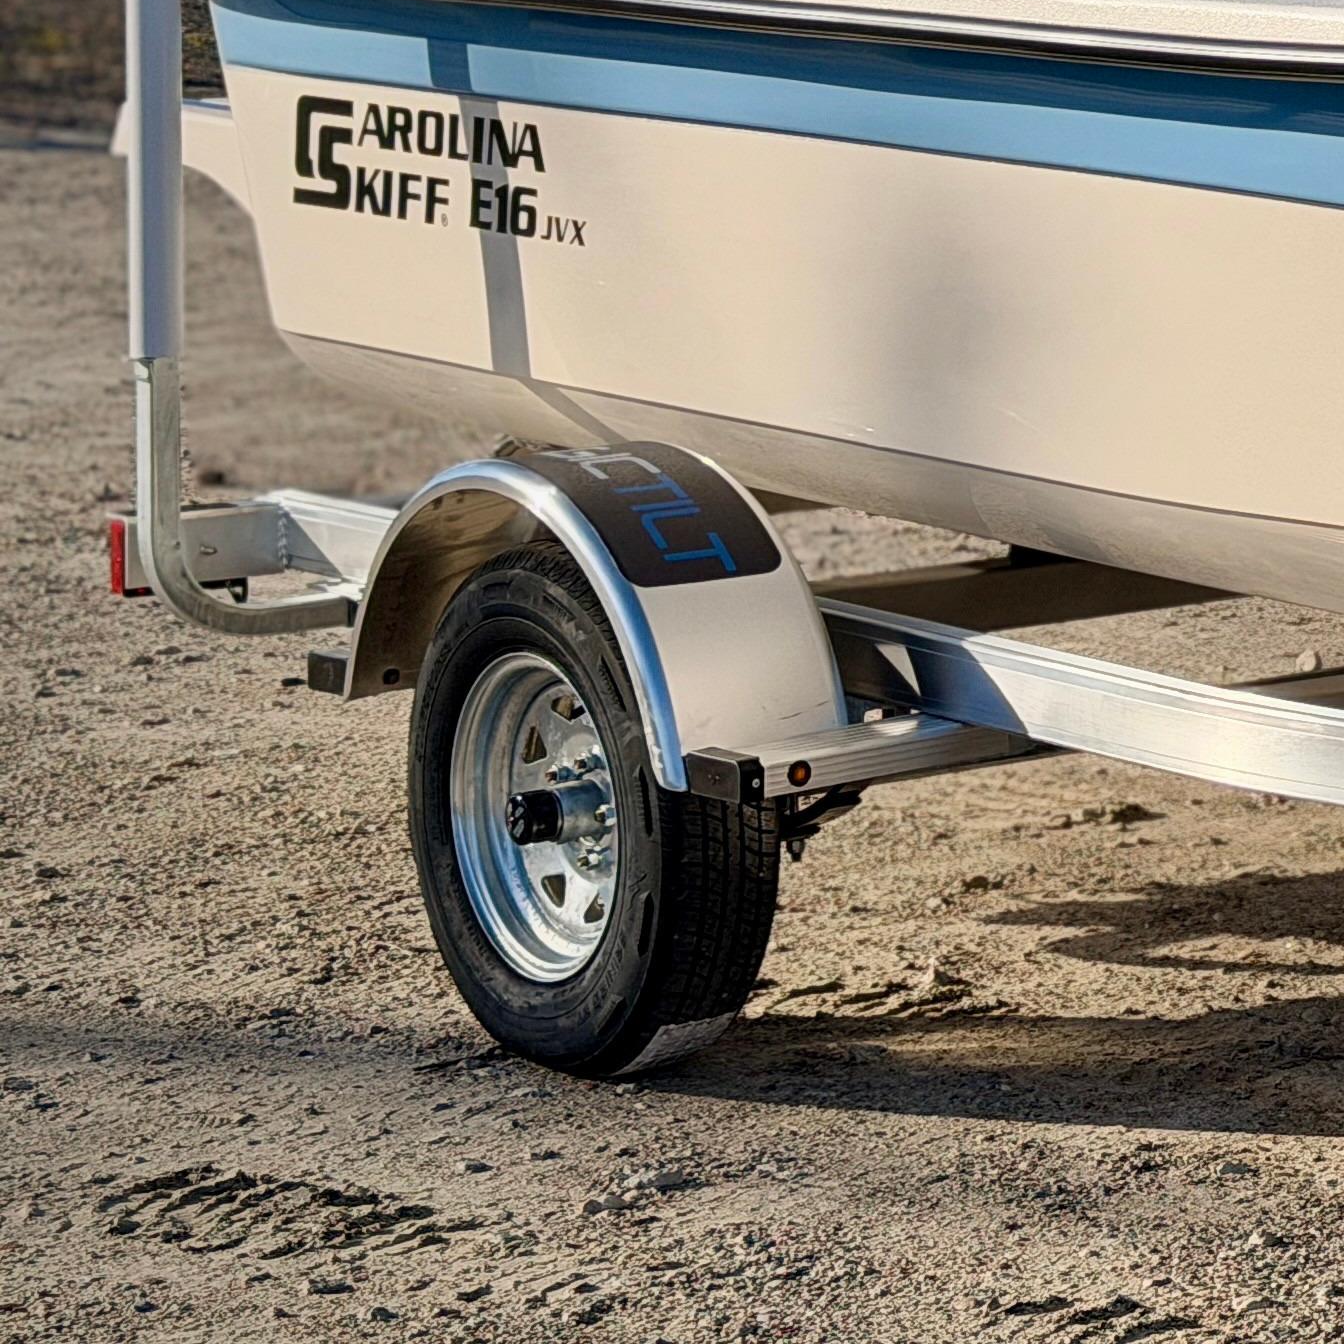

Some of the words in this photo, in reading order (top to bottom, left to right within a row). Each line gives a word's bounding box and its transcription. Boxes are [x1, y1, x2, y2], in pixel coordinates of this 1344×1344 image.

[295, 95, 546, 178] CAROLINA
[469, 175, 538, 238] E16
[541, 215, 587, 247] JVX
